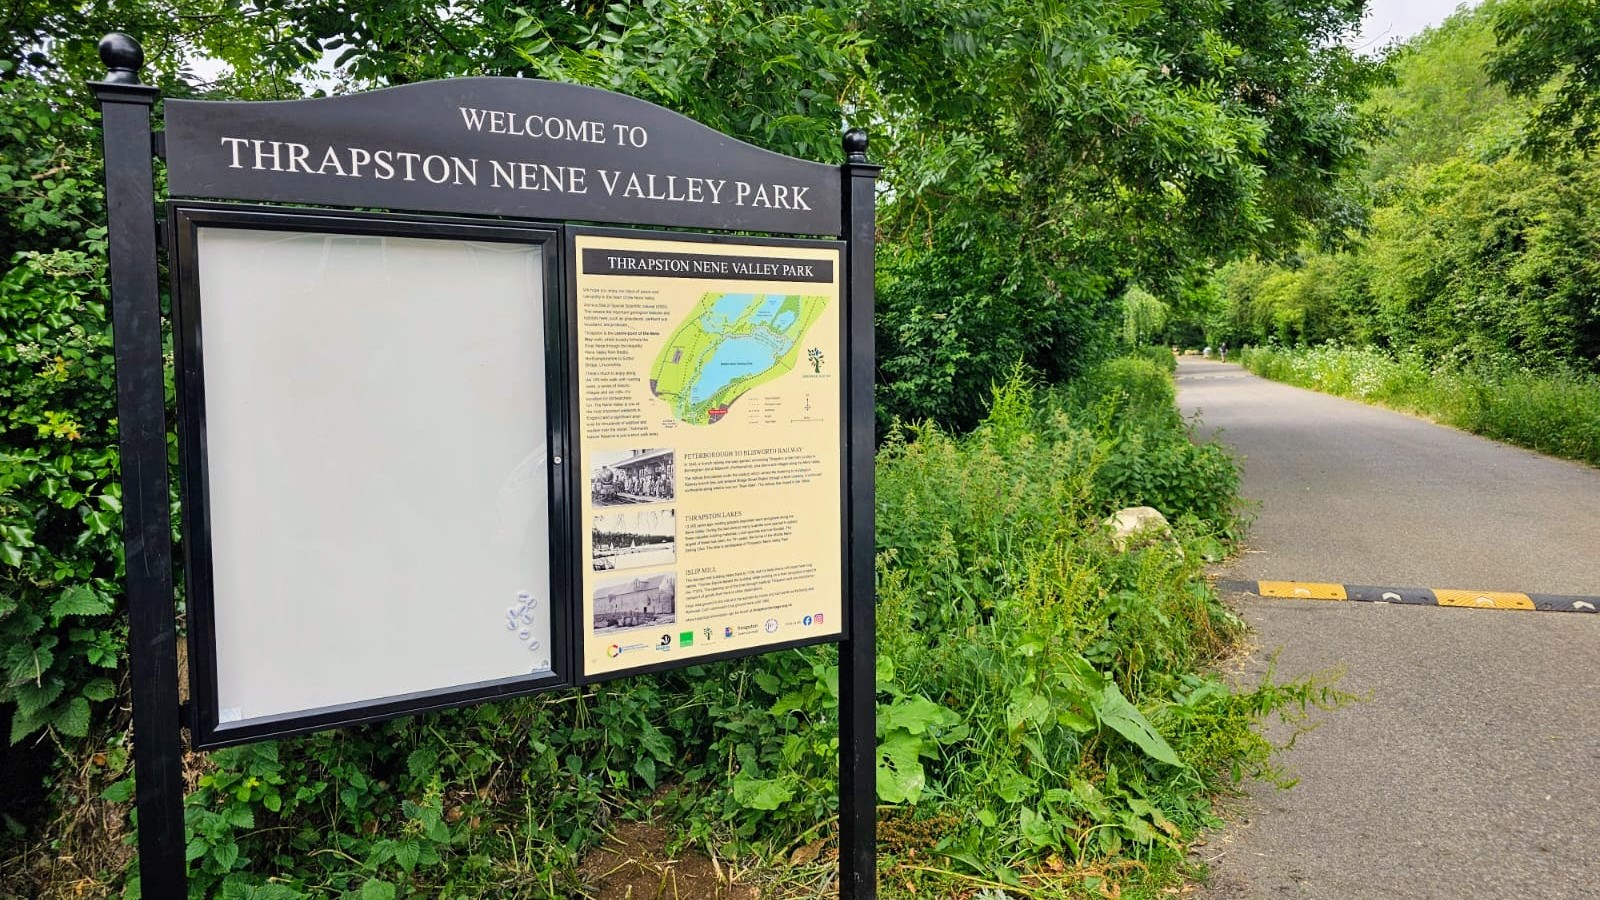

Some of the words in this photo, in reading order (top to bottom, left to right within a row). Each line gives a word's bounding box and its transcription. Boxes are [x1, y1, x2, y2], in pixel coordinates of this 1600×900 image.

[458, 106, 607, 144] WELCOME
[612, 123, 648, 148] TO
[220, 136, 479, 186] THRAPSTON
[488, 160, 588, 194] NENE
[597, 169, 727, 205] VALLEY
[735, 181, 812, 211] PARK
[606, 256, 690, 272] THRAPSTON
[692, 260, 728, 273] NENE
[732, 262, 780, 276] VALLEY
[782, 264, 814, 277] PARK
[684, 451, 733, 460] PETERBOROUGH
[777, 446, 803, 455] RAILWAY
[685, 513, 722, 522] THRAPSTON
[722, 511, 742, 519] LAKES
[685, 567, 701, 576] ISLIP
[701, 566, 717, 574] MILL
